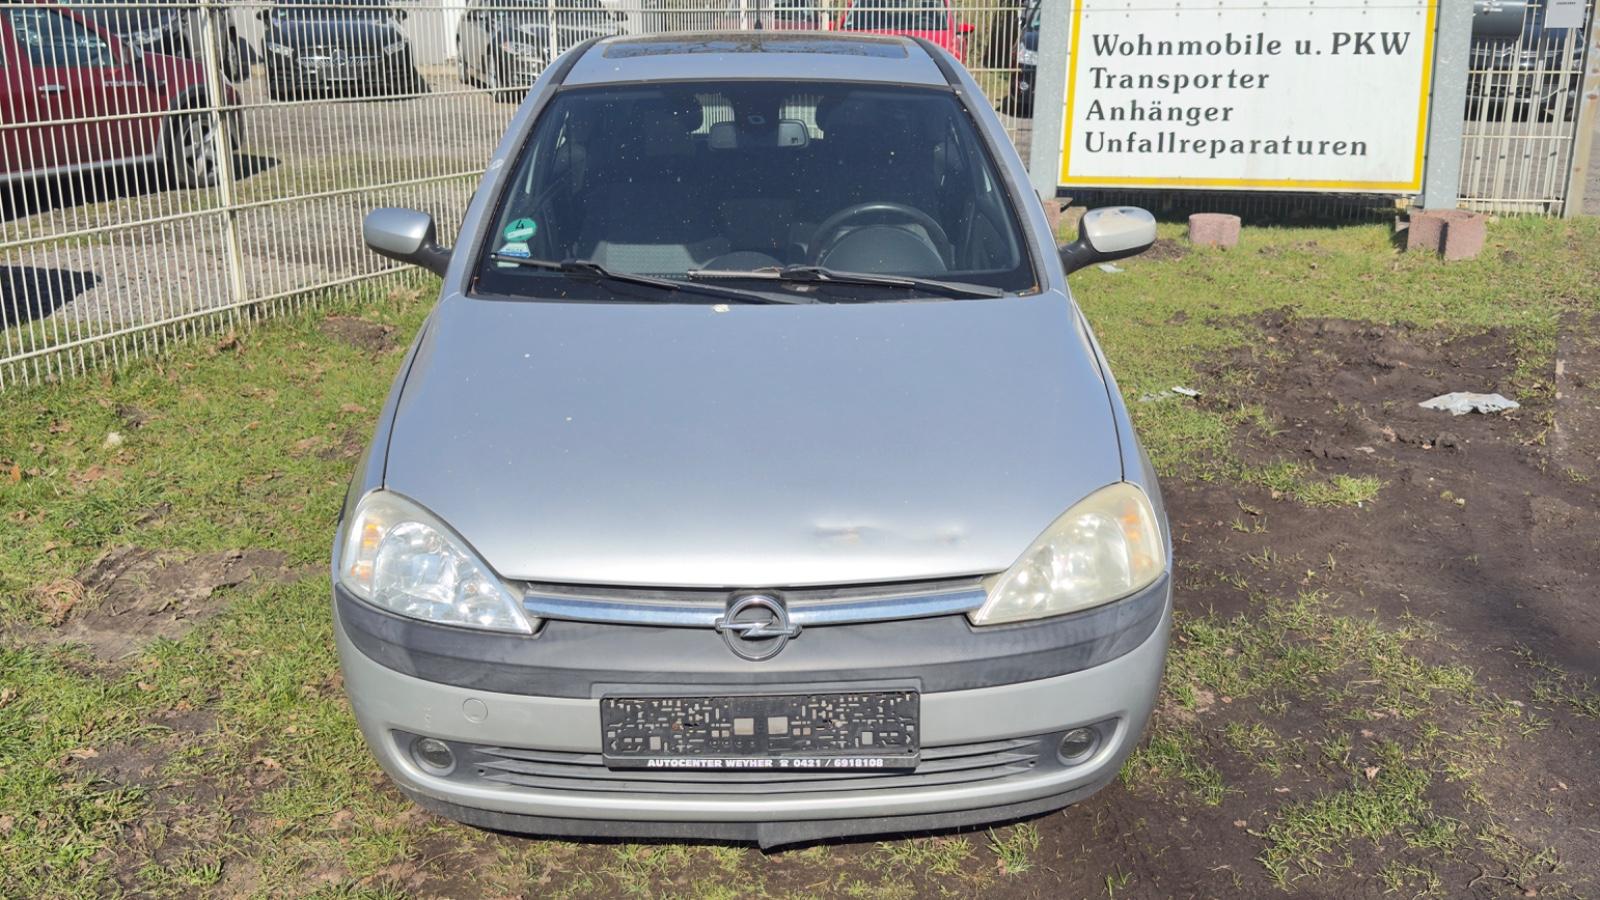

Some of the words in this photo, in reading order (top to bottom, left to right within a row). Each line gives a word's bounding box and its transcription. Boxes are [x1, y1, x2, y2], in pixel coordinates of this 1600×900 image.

[1092, 32, 1281, 57] Wohnmobile
[1295, 40, 1321, 56] u.
[1331, 31, 1411, 56] PKW
[1089, 67, 1270, 94] Transporter
[1086, 98, 1234, 127] Anhänger
[1085, 130, 1367, 159] Unfallreparaturen
[647, 759, 722, 768] AUTOCENTER
[724, 759, 773, 768] WEYHER
[793, 759, 821, 768] 0421
[833, 758, 884, 768] 6918108
